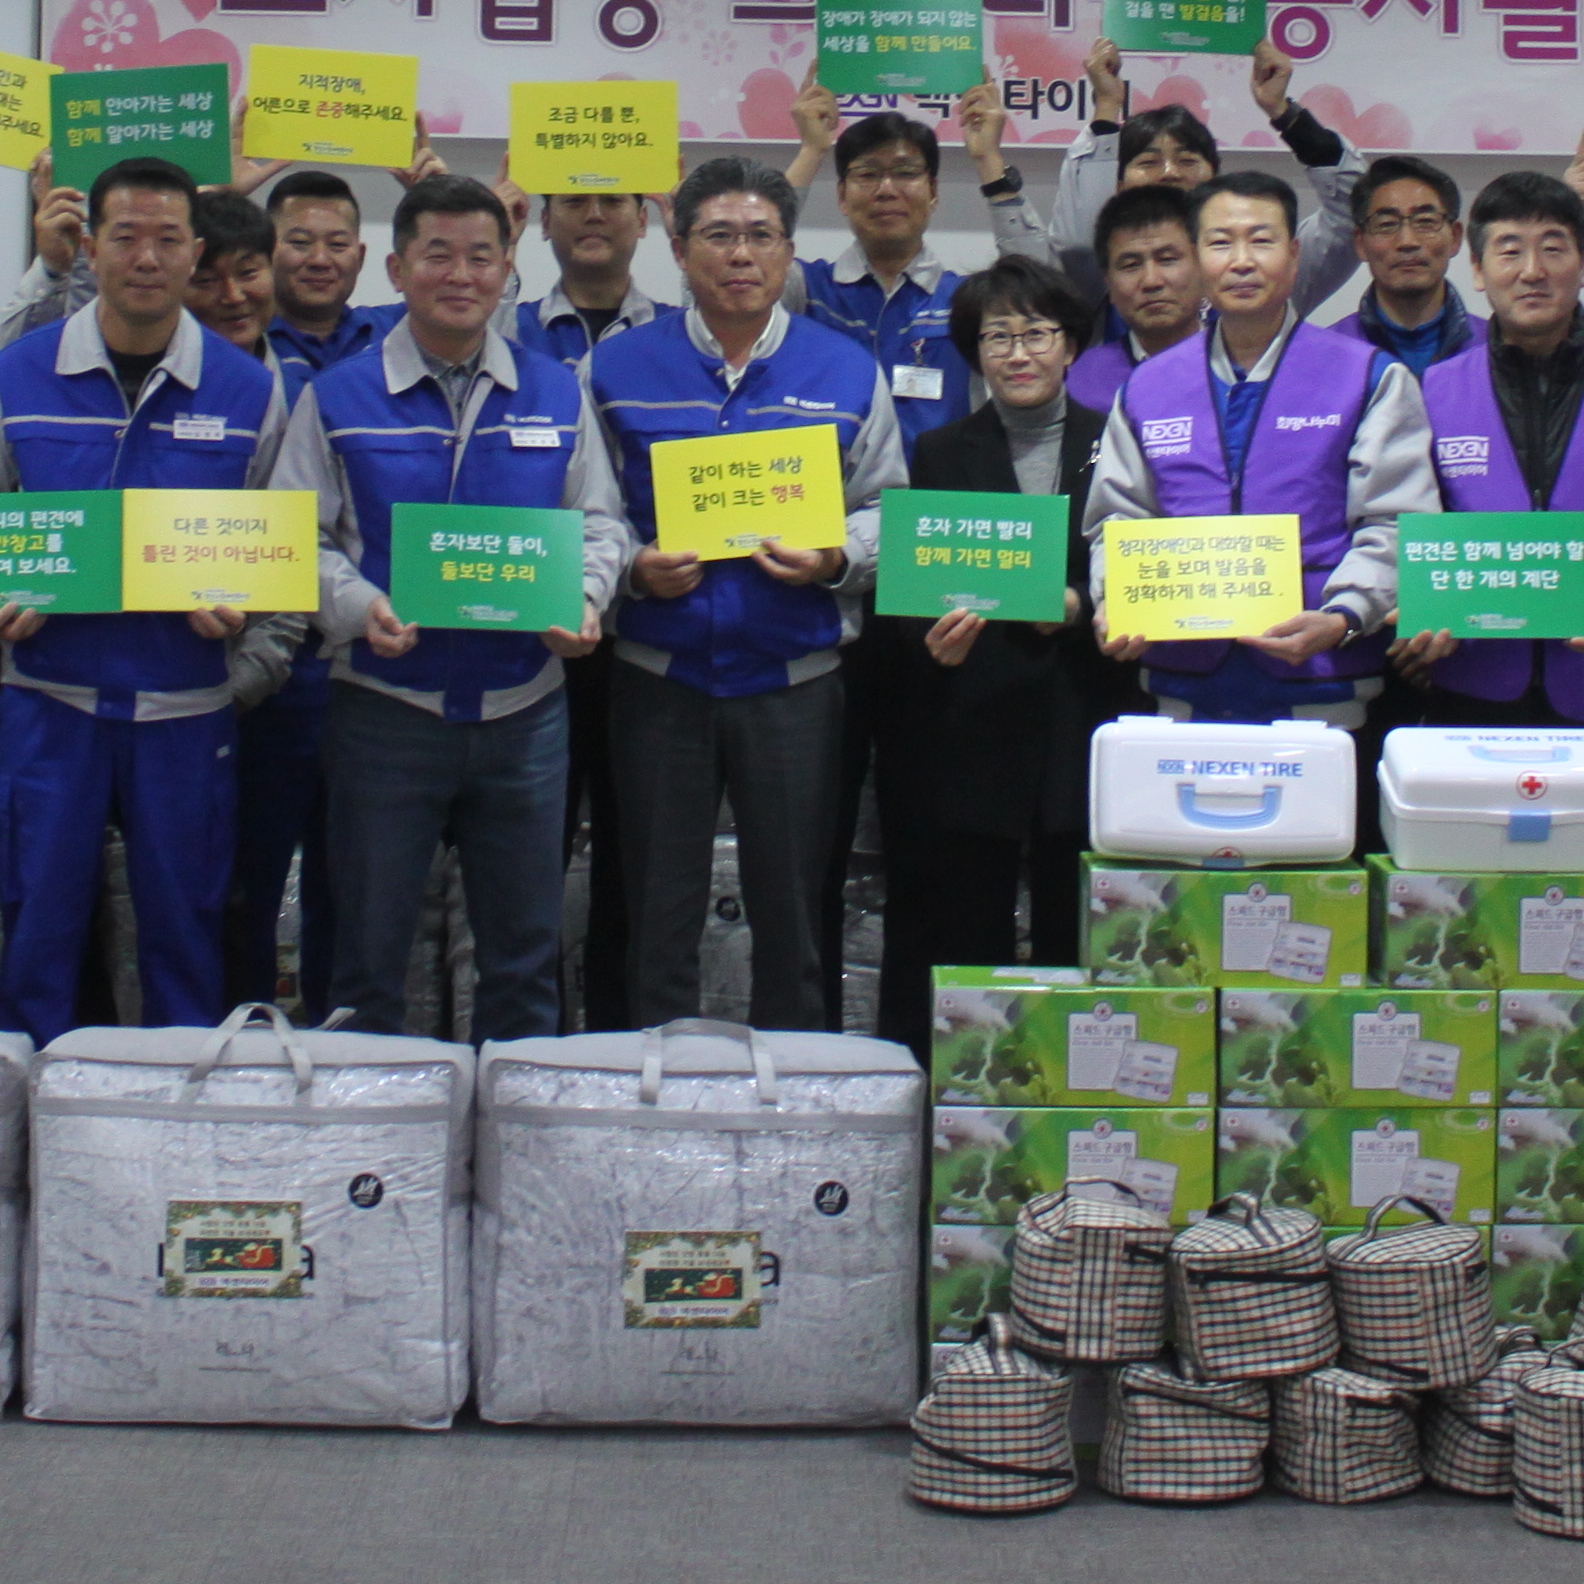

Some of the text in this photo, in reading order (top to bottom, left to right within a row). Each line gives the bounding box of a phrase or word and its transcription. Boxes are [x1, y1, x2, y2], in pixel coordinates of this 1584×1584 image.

[822, 11, 914, 28] 장애가 장애가
[823, 35, 907, 53] 세상을 함께
[67, 92, 213, 119] 함께 안아가는 세상
[253, 96, 311, 114] 어른으로
[548, 107, 578, 124] 조금
[67, 120, 214, 147] 함께 세상
[535, 133, 596, 149] 특별하지
[690, 456, 802, 484] 같이 하는 세상
[693, 483, 805, 512] 같이 크는 행복
[30, 510, 85, 529] 편견에
[174, 518, 267, 535] 다른 것이지
[917, 516, 1033, 540] 혼자 가면 빨리
[143, 545, 300, 563] 틀린 것이 아닙니다.
[430, 532, 547, 557] 혼자보단 둘이,
[1119, 536, 1285, 556] 청각장애인과 대화할 때는
[1405, 541, 1458, 562] 편견은
[1464, 541, 1501, 562] 함께
[1507, 541, 1562, 562] 넘어야
[18, 556, 76, 574] 보세요.
[916, 546, 1032, 570] 함께 가면 멀리
[1138, 557, 1266, 579] 눈을 보며 발음을
[441, 561, 536, 582] 둘보단 우리
[1431, 570, 1560, 590] 단 한 개의 계단
[1124, 583, 1216, 603] 정확하게 해
[1192, 761, 1255, 775] NEXEN
[1260, 762, 1303, 777] TIRE
